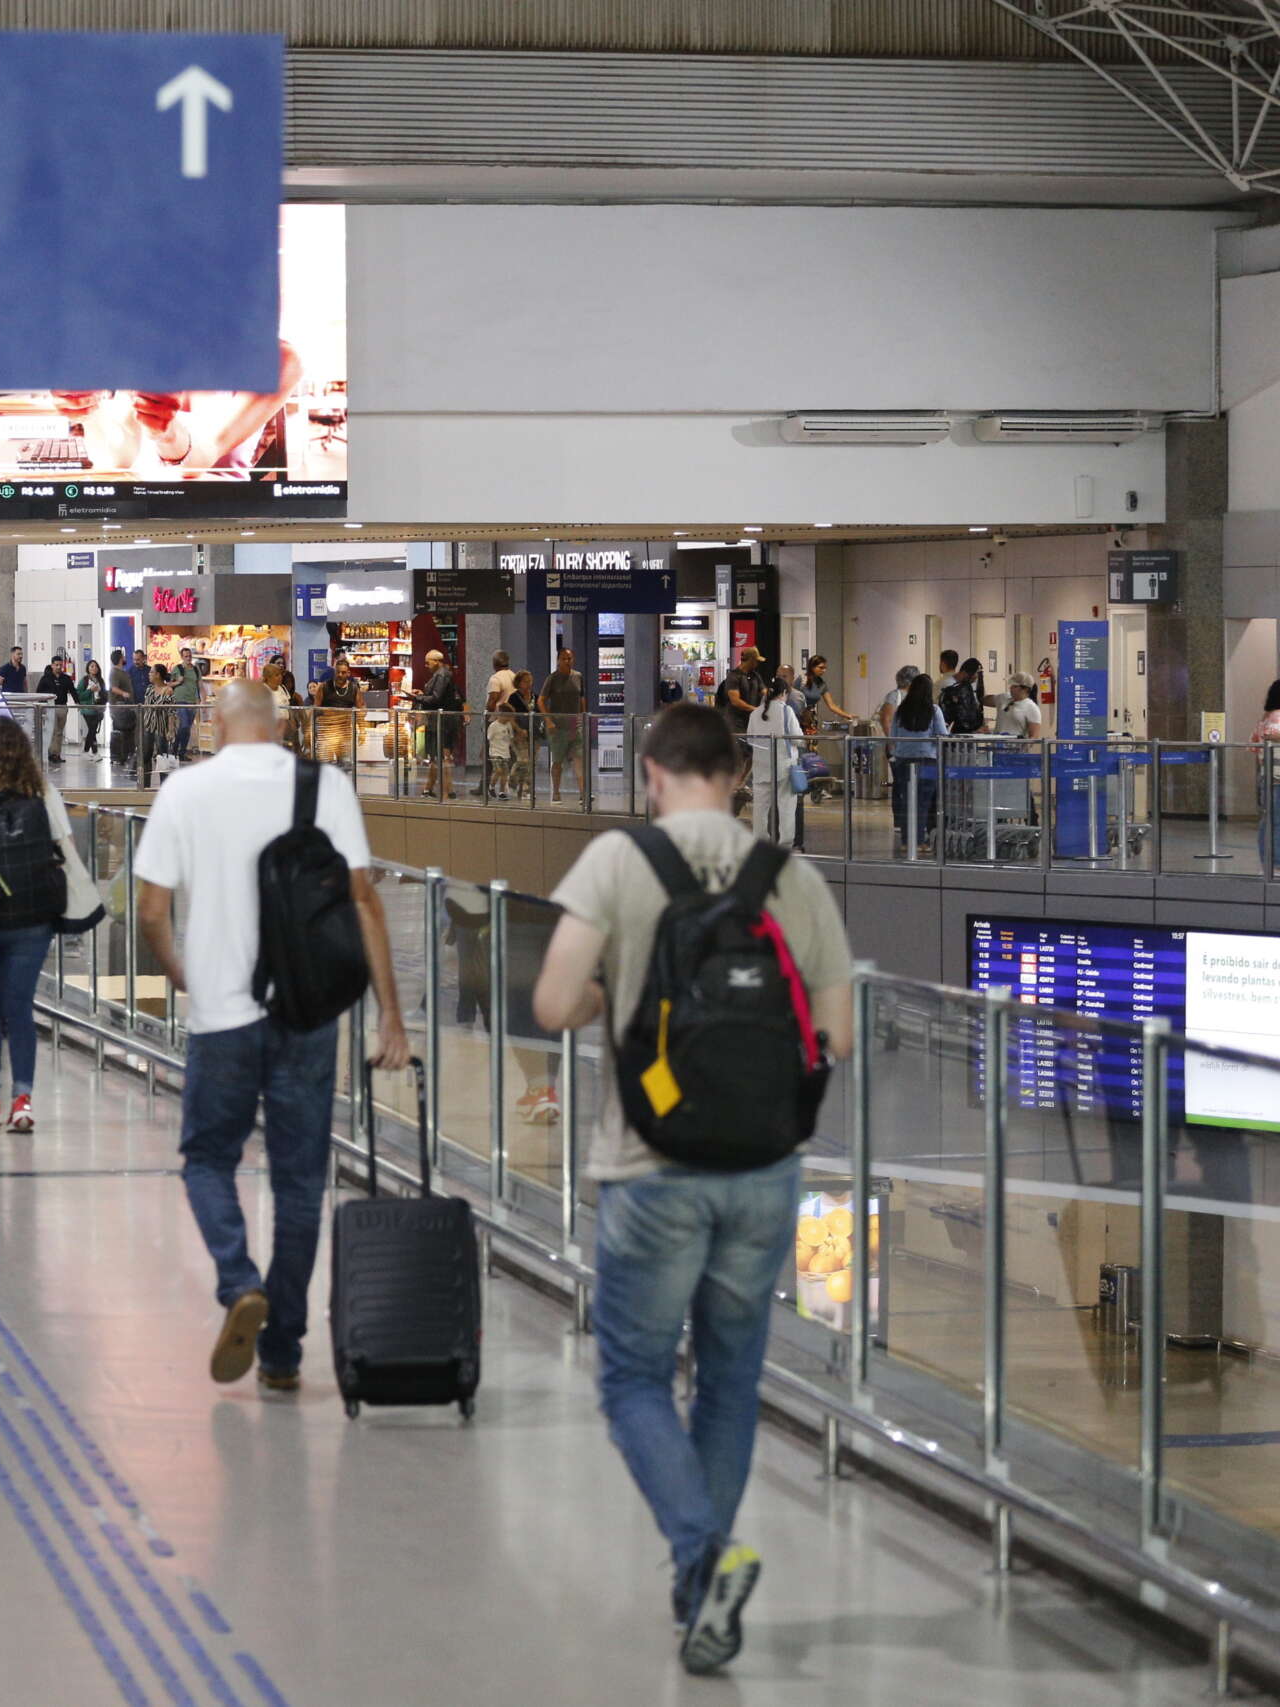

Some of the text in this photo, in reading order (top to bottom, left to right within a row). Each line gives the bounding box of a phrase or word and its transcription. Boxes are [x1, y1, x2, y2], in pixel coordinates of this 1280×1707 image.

[586, 551, 631, 570] SHOPPING
[1210, 956, 1250, 968] proibido
[1252, 959, 1269, 969] sair
[1202, 971, 1276, 987] levando plantas
